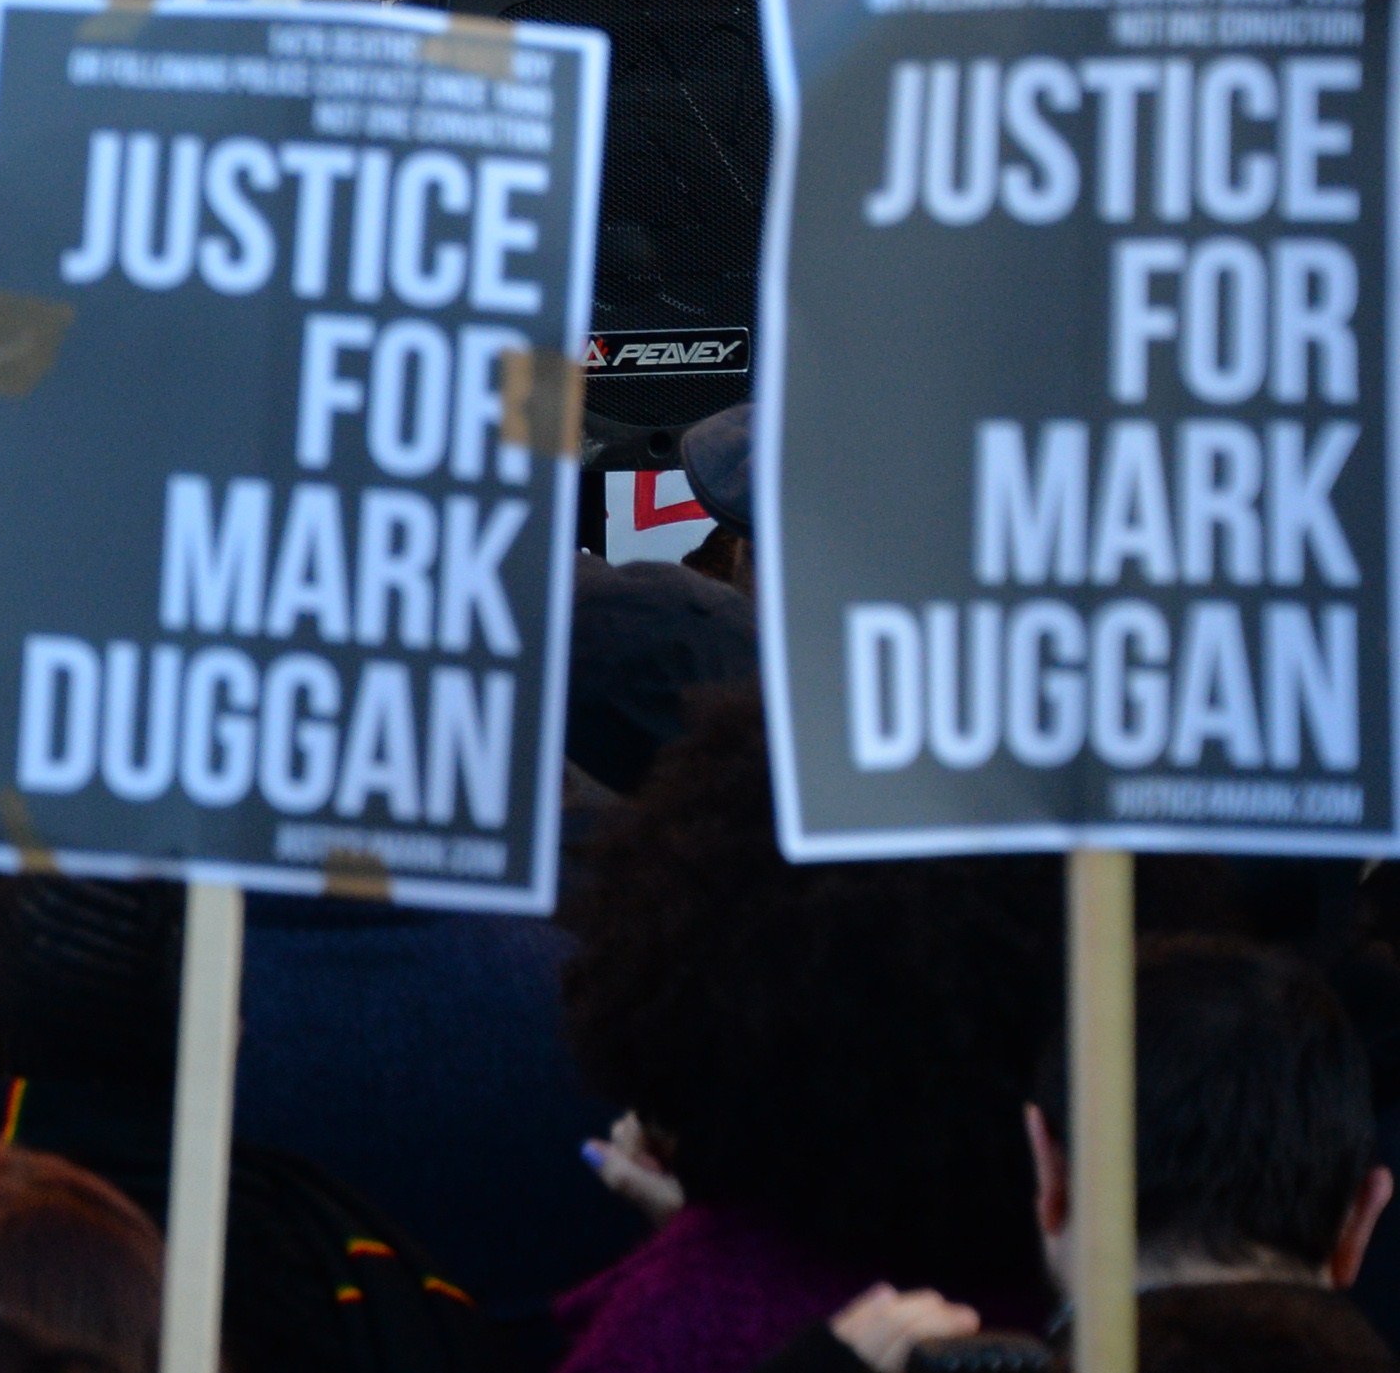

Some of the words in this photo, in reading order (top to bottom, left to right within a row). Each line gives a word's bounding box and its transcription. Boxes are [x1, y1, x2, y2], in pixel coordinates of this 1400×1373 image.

[60, 129, 550, 314] JUSTICE
[863, 55, 1361, 228] JUSTICE
[612, 340, 742, 367] PEAVEY
[1110, 237, 1360, 406] FOR
[159, 473, 529, 659] MARK
[973, 418, 1361, 587] MARK
[17, 631, 516, 830] DUGGAN
[845, 599, 1361, 773] DUGGAN
